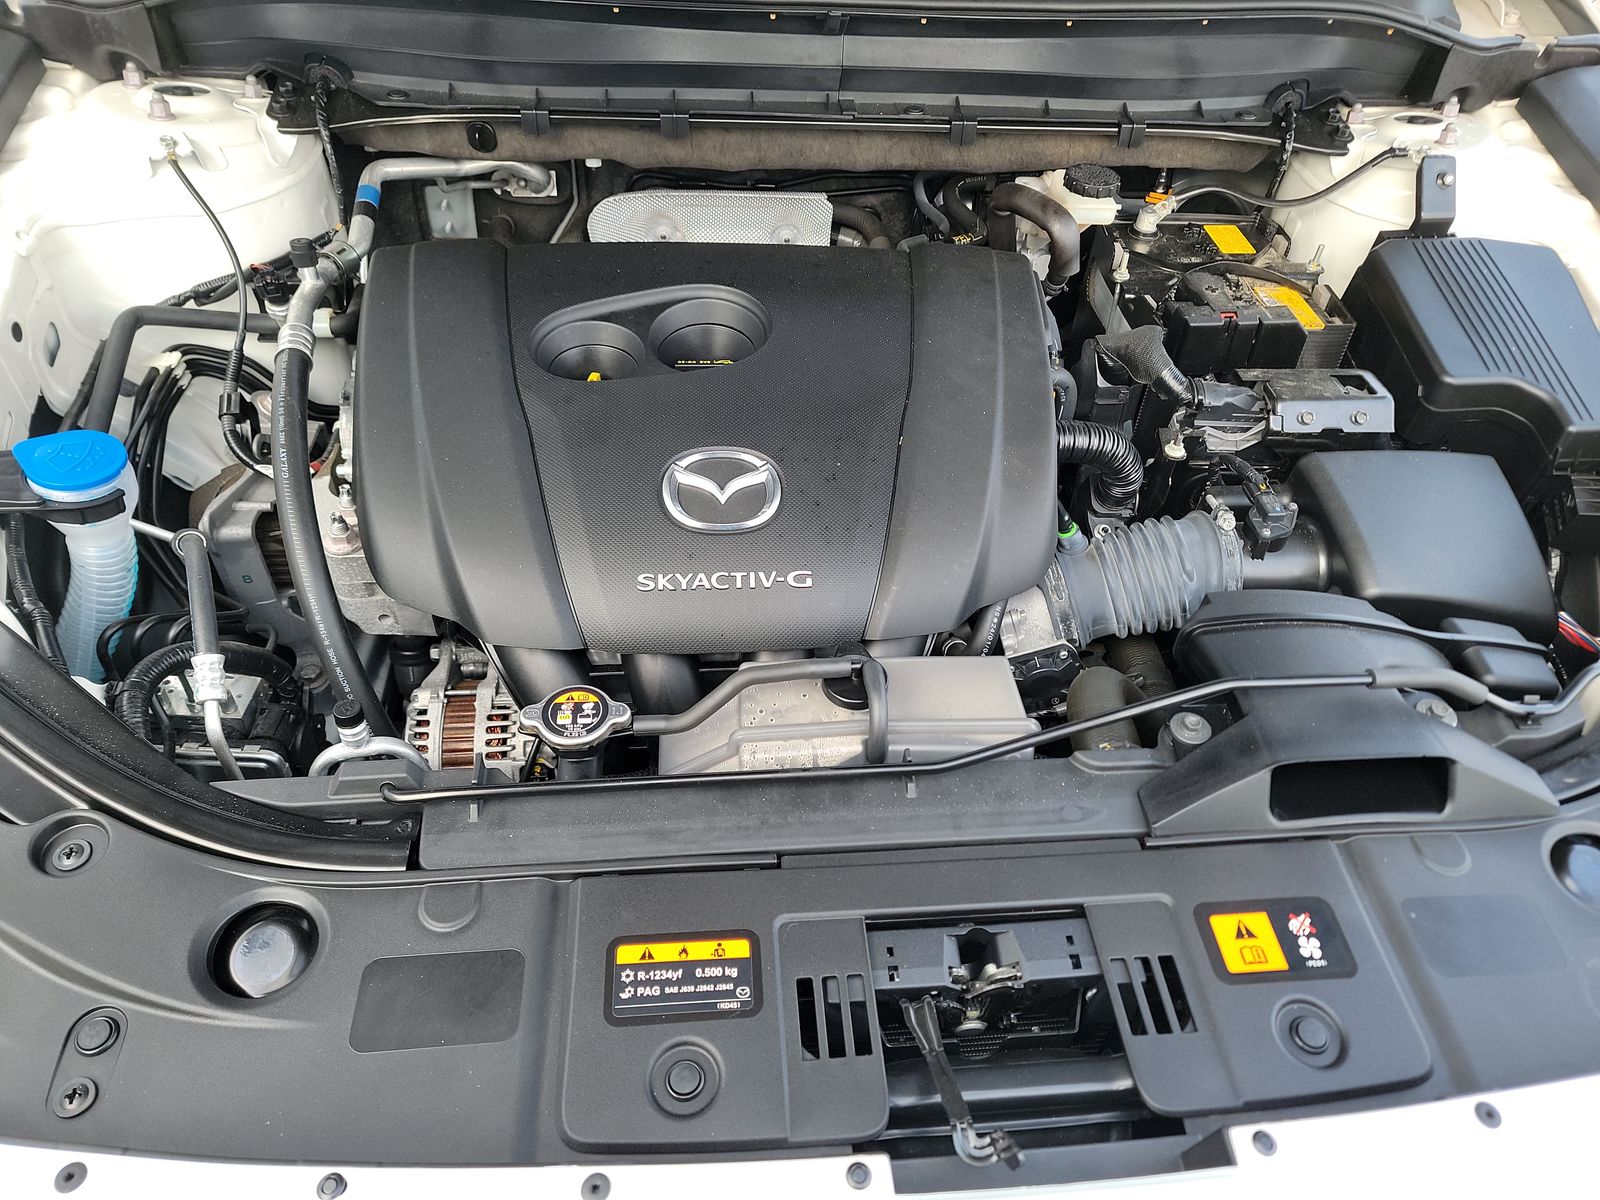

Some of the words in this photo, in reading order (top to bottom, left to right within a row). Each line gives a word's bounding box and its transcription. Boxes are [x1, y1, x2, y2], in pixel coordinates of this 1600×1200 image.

[280, 447, 289, 479] GALAXY
[636, 570, 813, 591] SKYACTIV-G
[326, 647, 339, 665] HOSE
[335, 666, 350, 693] SUCTION
[637, 968, 683, 981] R-1234yf
[695, 967, 722, 978] 0.500
[725, 966, 738, 978] kg
[637, 986, 661, 997] PAG
[664, 986, 679, 994] SAE
[679, 985, 695, 993] J639
